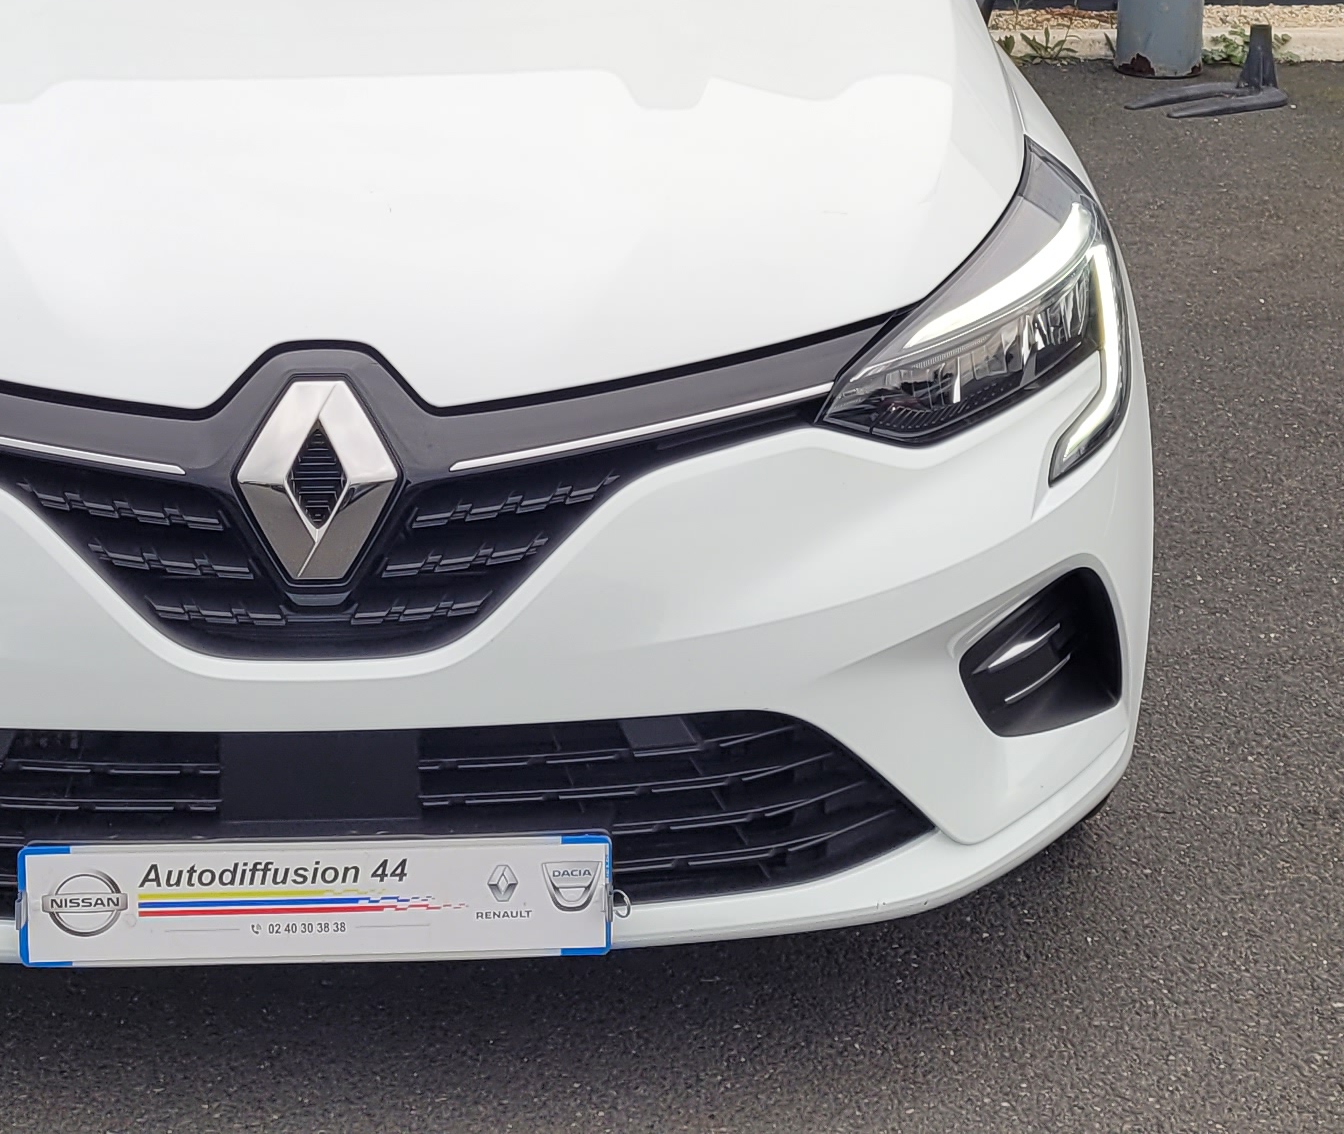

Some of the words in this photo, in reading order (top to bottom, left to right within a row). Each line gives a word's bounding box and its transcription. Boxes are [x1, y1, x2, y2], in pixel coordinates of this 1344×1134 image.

[138, 860, 361, 889] Autodiffusion
[370, 858, 408, 883] 44
[552, 868, 592, 878] DACIA
[50, 895, 120, 910] NISSAN
[476, 910, 532, 920] RENAULT
[268, 923, 282, 935] 02
[284, 923, 299, 935] 40
[301, 922, 315, 934] 30
[316, 922, 331, 934] 38
[332, 921, 347, 933] 38
